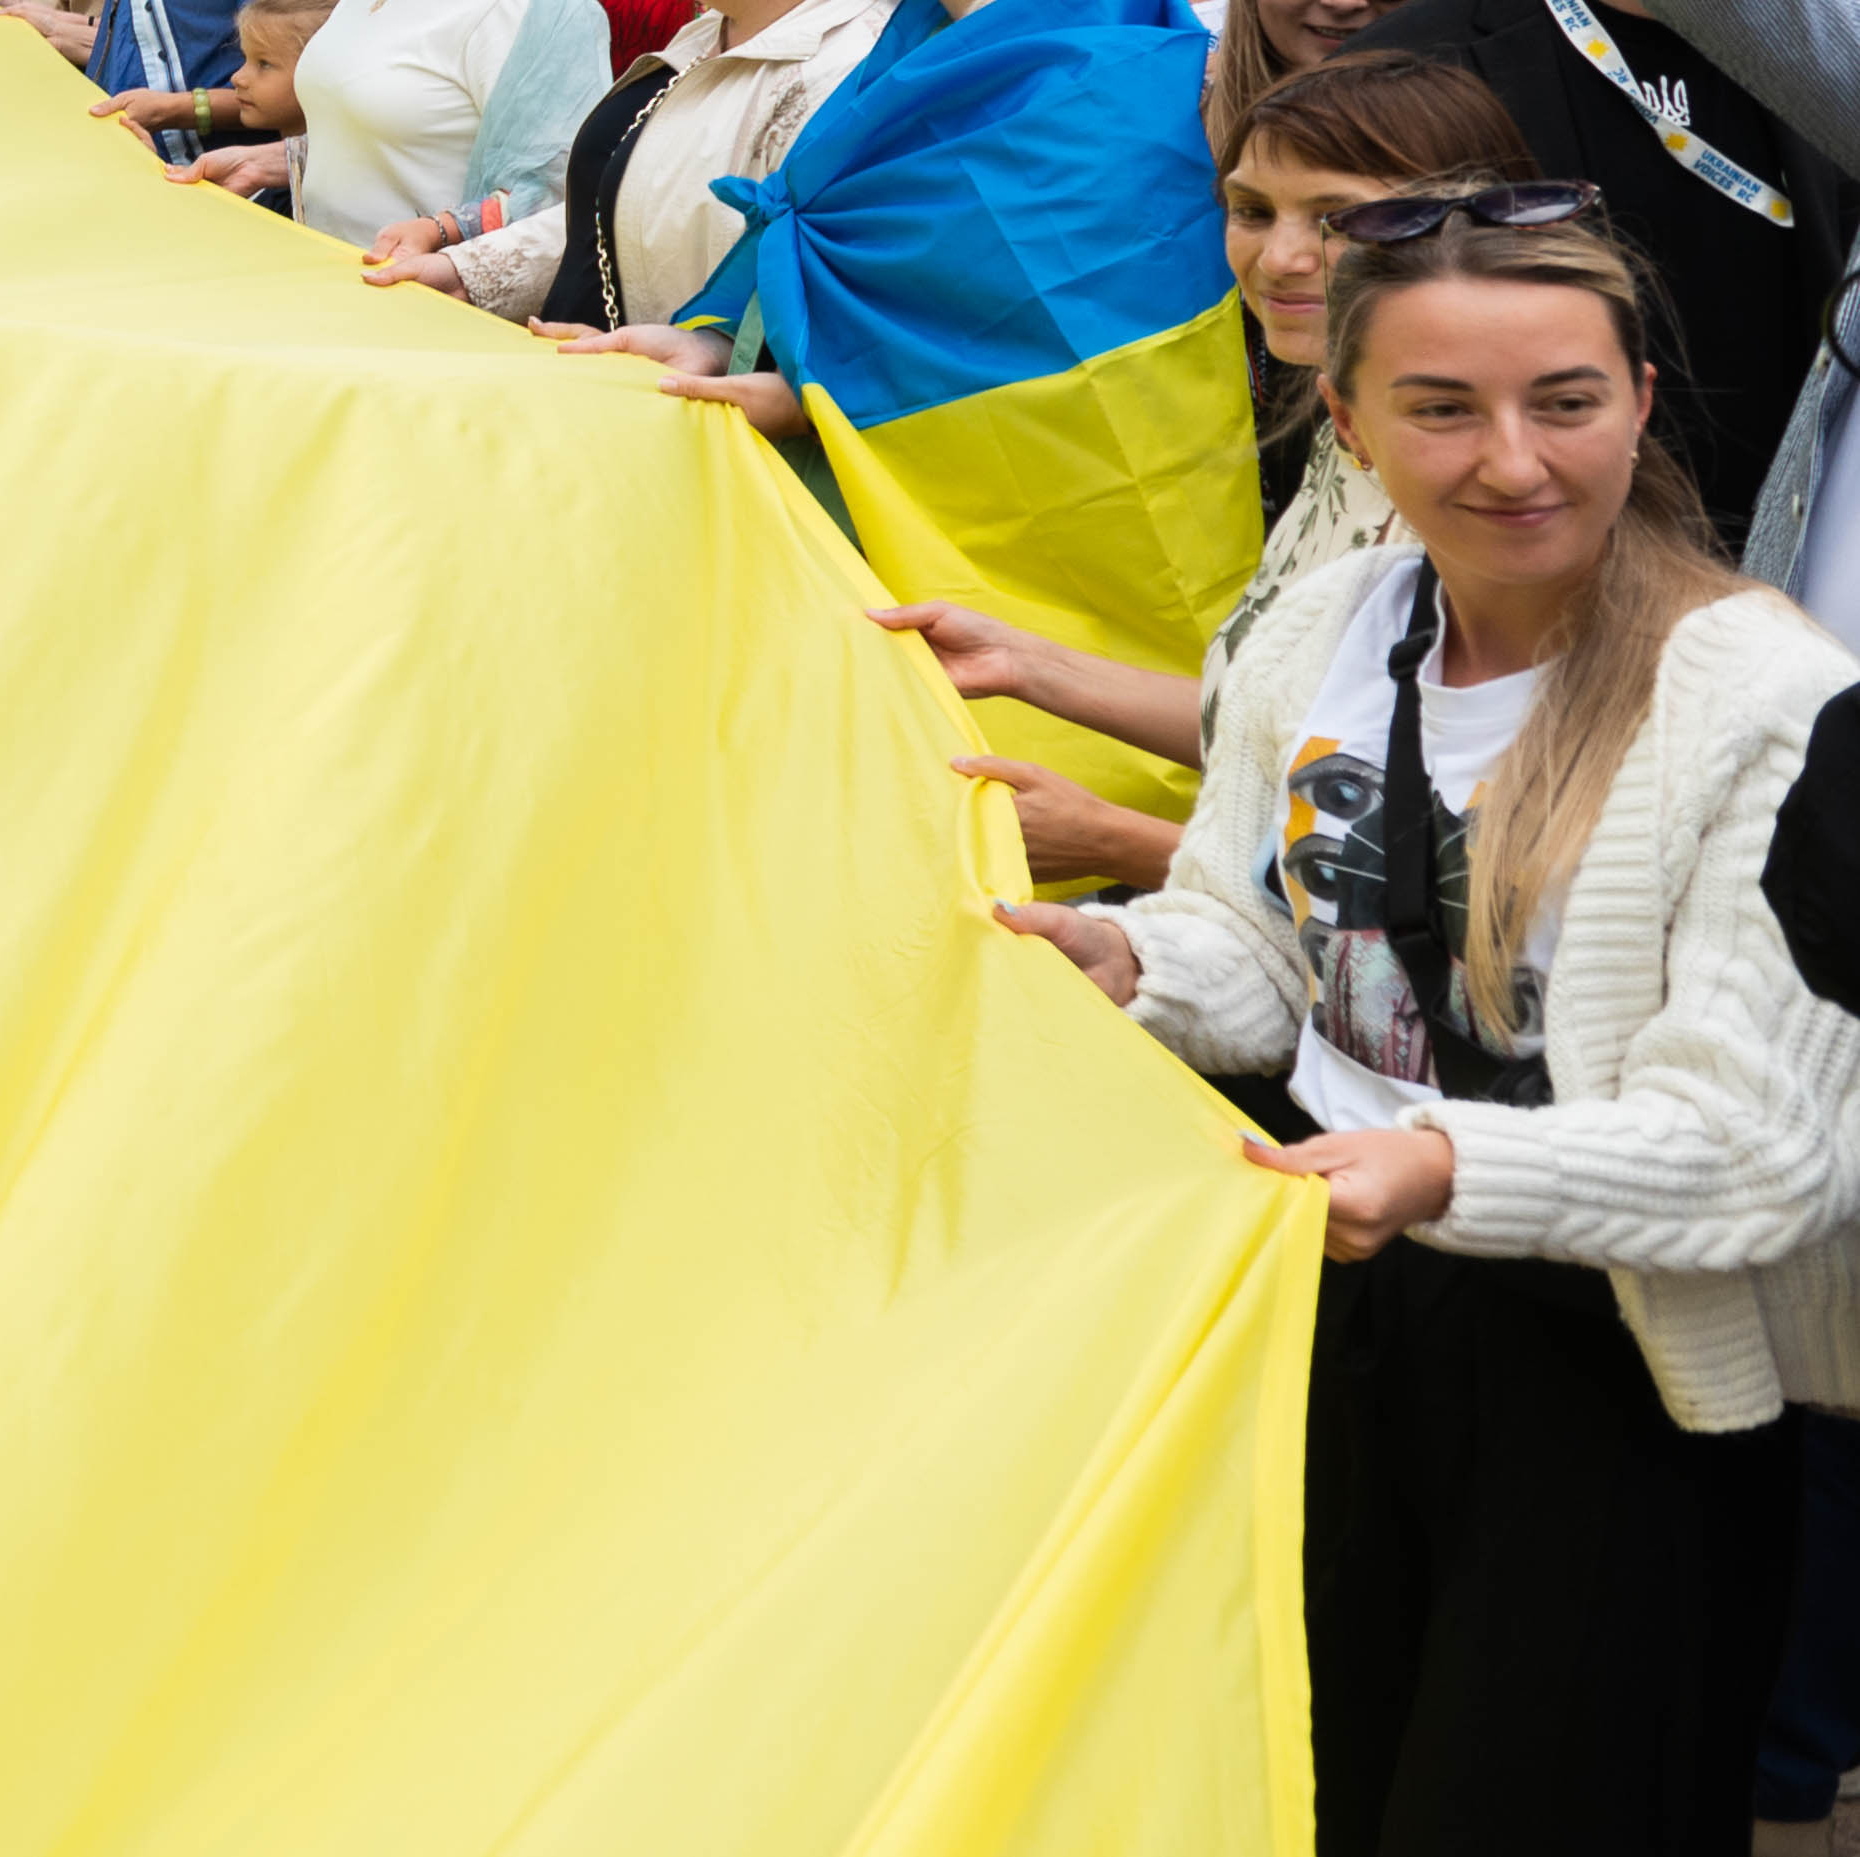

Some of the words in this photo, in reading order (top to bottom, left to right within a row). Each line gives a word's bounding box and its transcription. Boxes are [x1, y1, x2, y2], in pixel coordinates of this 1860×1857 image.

[1562, 16, 1581, 33] RC
[1692, 159, 1735, 191] VOICES
[1735, 187, 1757, 204] RC
[1700, 149, 1762, 194] UKRAINIAN
